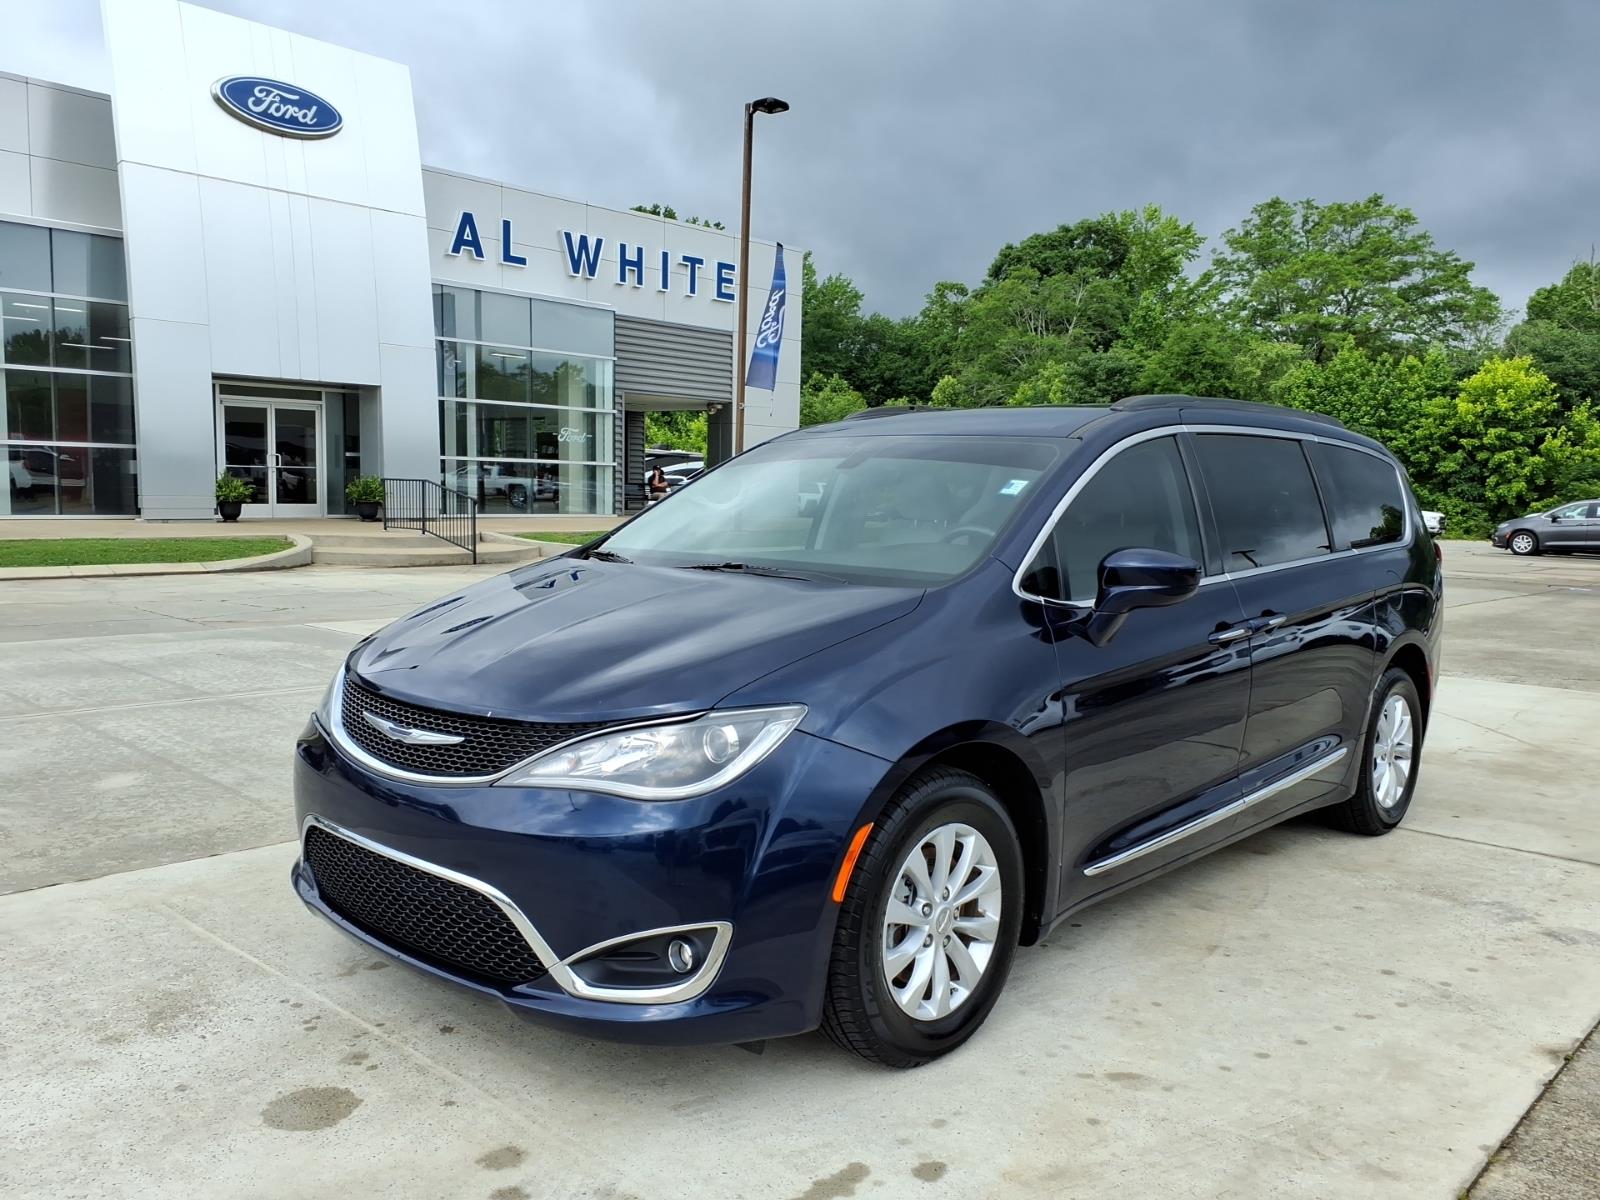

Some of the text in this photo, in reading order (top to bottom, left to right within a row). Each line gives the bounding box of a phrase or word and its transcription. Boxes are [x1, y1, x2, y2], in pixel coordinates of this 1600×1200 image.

[248, 86, 317, 124] Ford
[449, 210, 736, 302] AL WHITE
[557, 427, 587, 443] Ford
